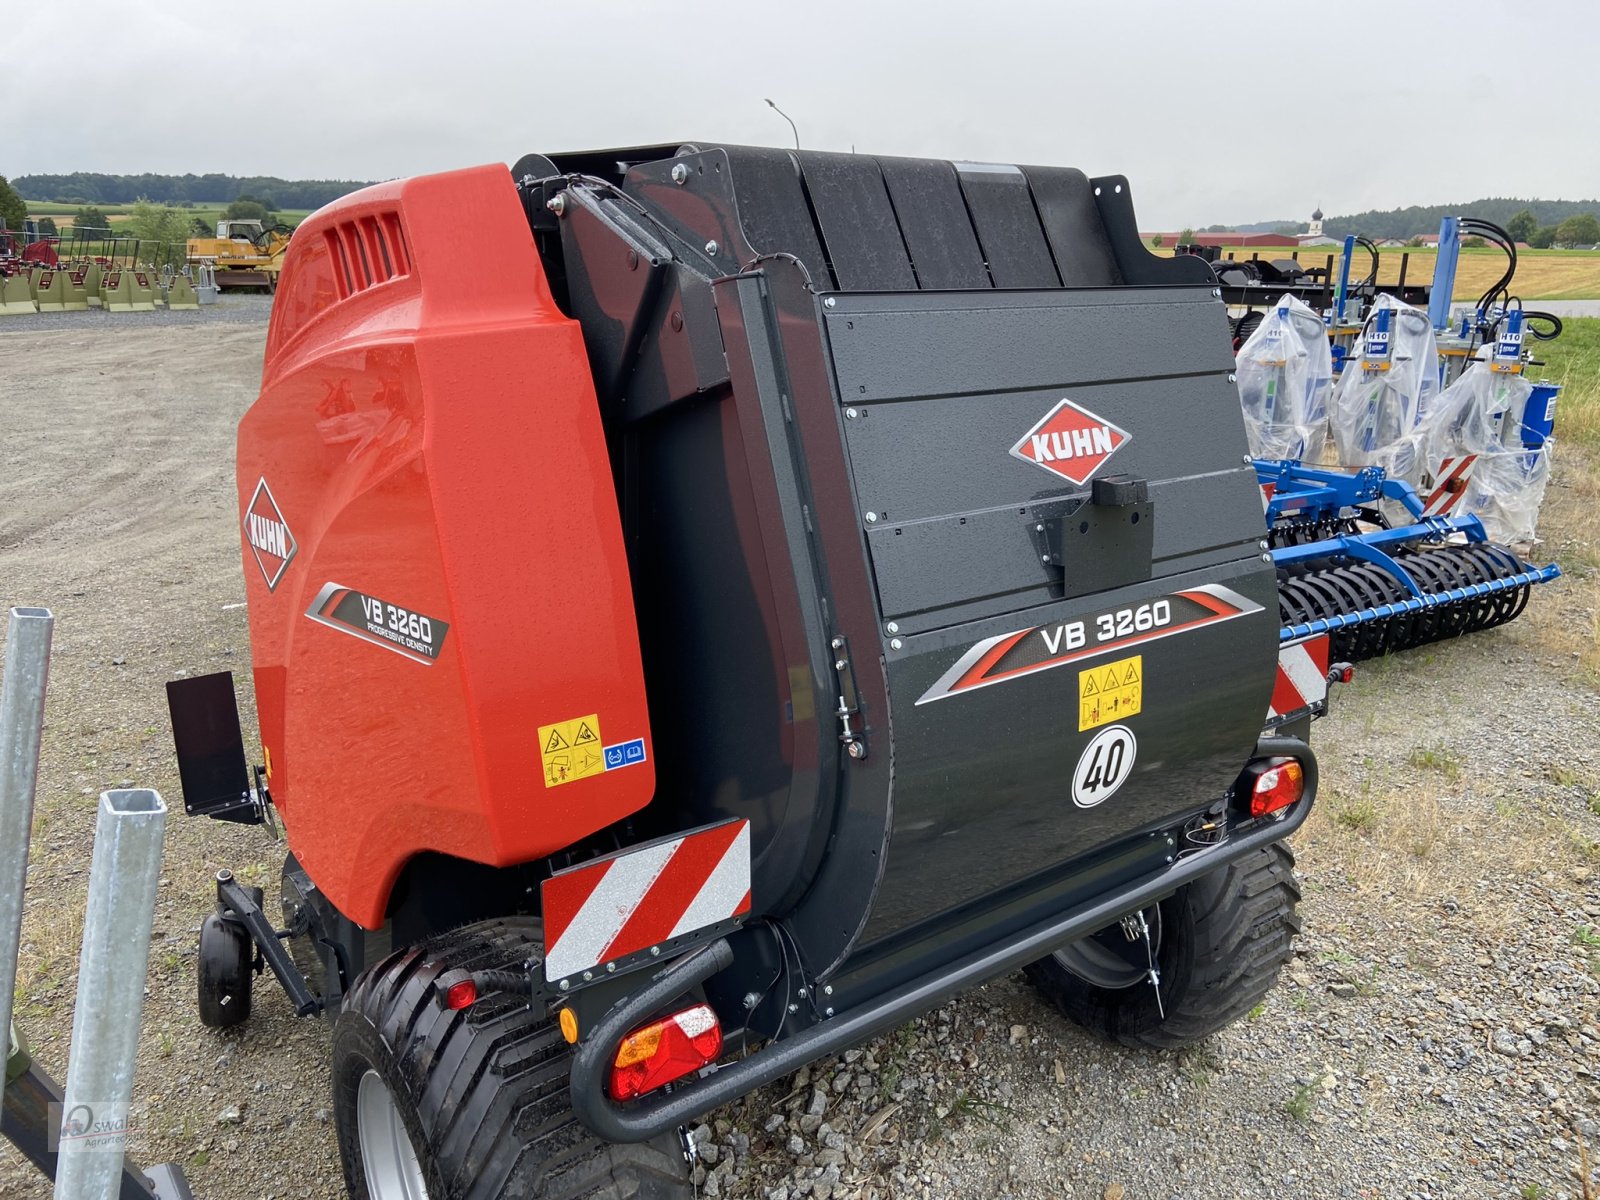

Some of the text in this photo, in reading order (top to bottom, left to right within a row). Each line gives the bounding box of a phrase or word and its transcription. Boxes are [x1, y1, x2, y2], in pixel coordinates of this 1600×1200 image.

[1370, 332, 1387, 340] H10
[1501, 333, 1520, 341] H10
[1031, 426, 1113, 463] KUHN
[249, 512, 287, 560] KUHN
[360, 594, 432, 644] VB 3260
[367, 621, 433, 656] PROGRESSIVE DENSITY
[1040, 599, 1171, 655] VB 3260
[1081, 738, 1125, 794] 40
